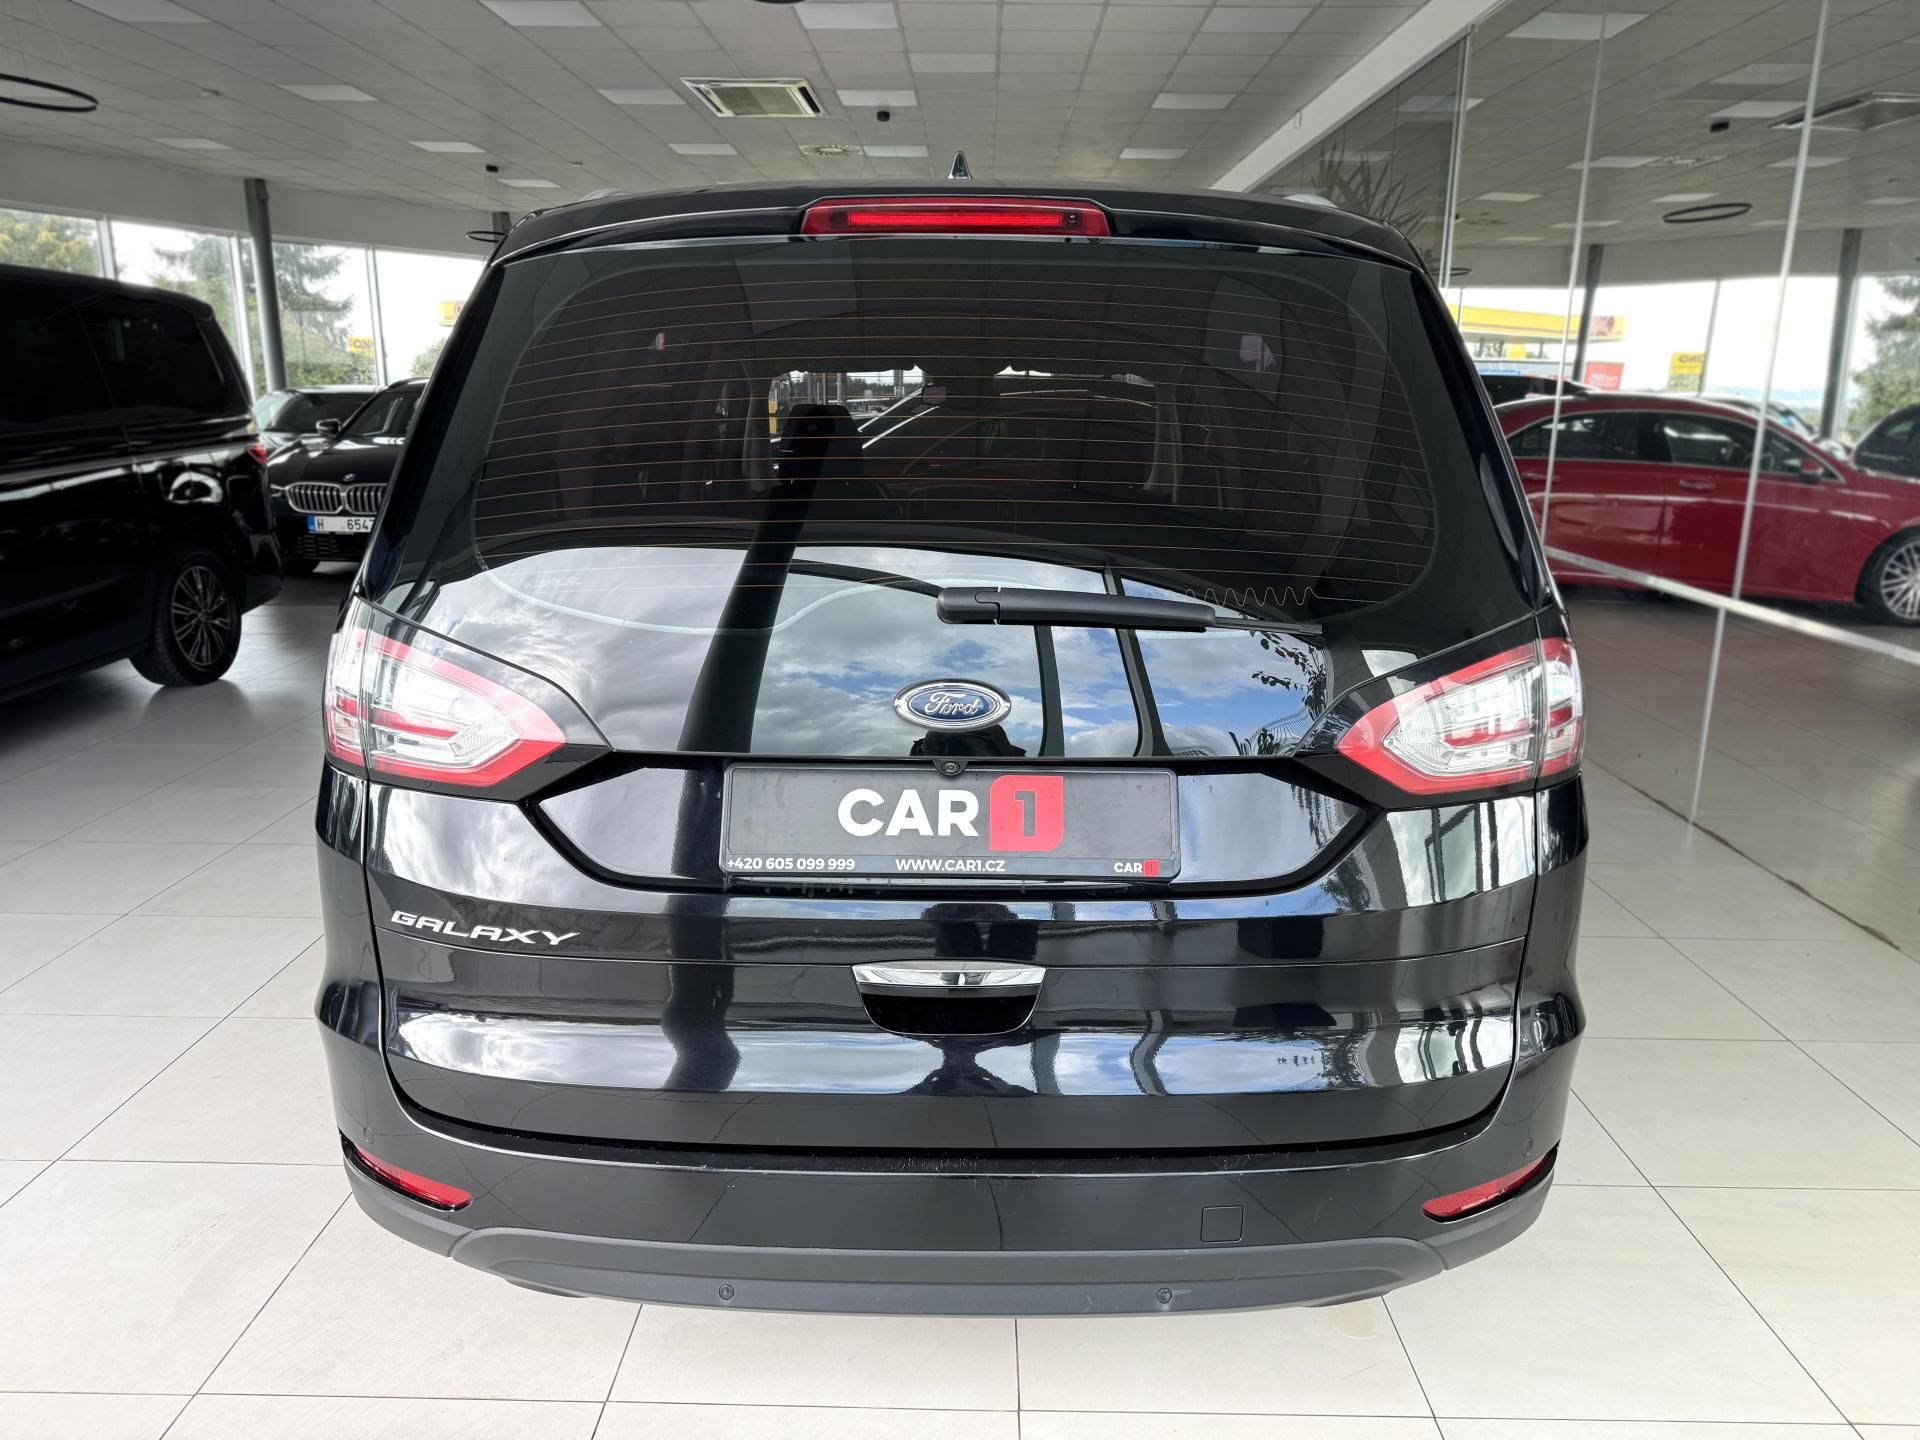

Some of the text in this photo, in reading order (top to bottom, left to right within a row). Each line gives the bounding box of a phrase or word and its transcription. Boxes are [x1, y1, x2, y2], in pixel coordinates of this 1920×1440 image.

[317, 518, 324, 529] H
[924, 691, 981, 716] Ford
[838, 788, 979, 837] CAR
[727, 858, 855, 870] +420 605 099 999
[895, 859, 1006, 872] WWW.CAR1.CZ
[1114, 862, 1142, 873] CAR
[390, 910, 581, 945] GALAXY
